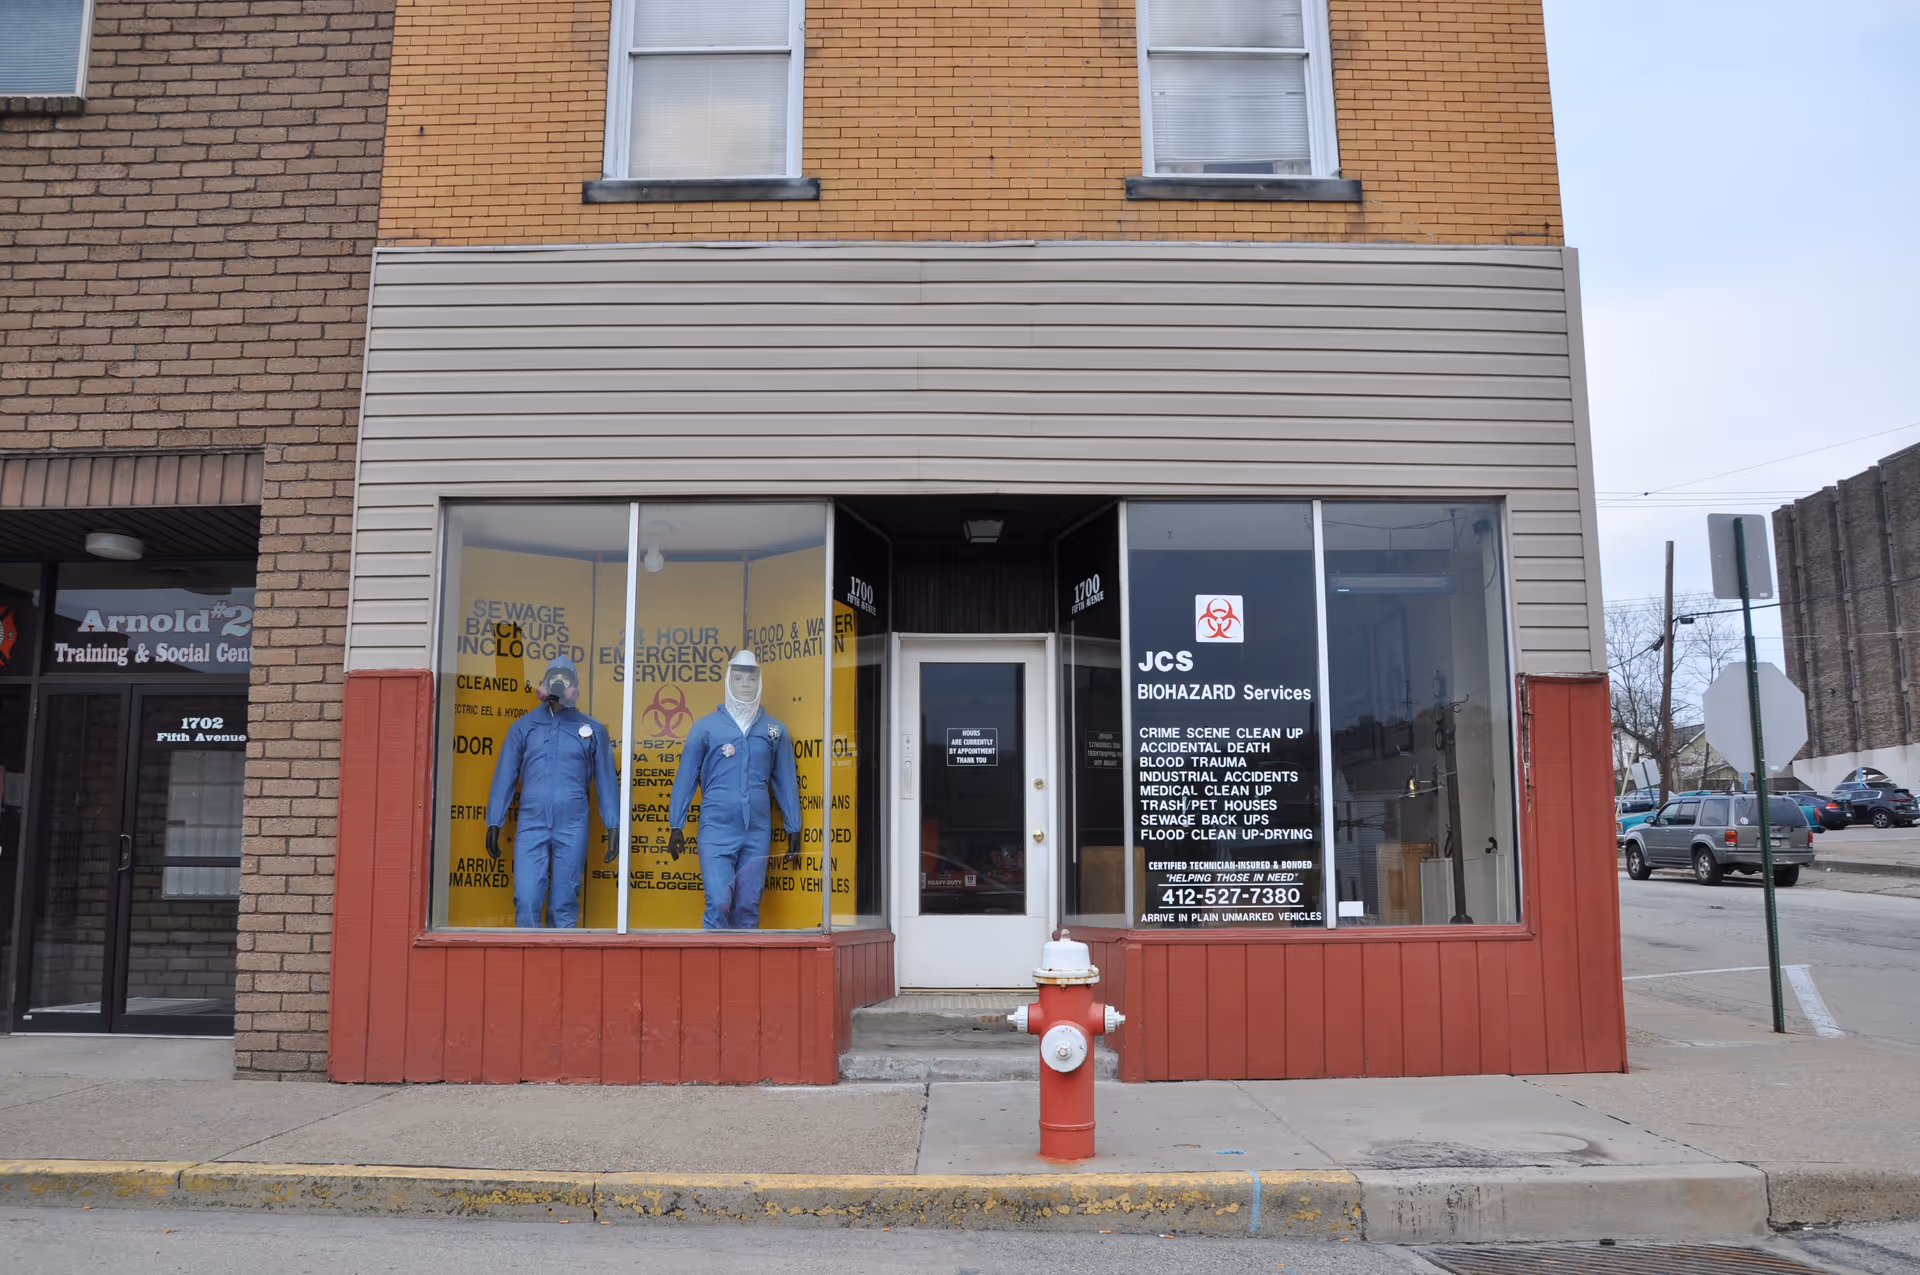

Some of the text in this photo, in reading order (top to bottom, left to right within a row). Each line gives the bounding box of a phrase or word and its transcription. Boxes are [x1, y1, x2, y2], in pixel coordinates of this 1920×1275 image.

[851, 576, 873, 604] 1700
[1074, 573, 1100, 603] 1700
[472, 598, 566, 625] SEWAGE
[77, 609, 210, 633] Arnold
[465, 617, 570, 643] BACKUPS
[746, 613, 853, 647] FLOOD & WAER
[656, 626, 720, 647] HOUR
[55, 643, 129, 666] Training
[134, 642, 150, 664] &
[156, 643, 210, 664] Social
[755, 634, 844, 663] RESTORATIN
[1138, 650, 1194, 673] JCS
[456, 674, 519, 693] CLEANED
[524, 679, 533, 694] &
[1137, 683, 1312, 701] BIOHAZARD Services
[180, 717, 224, 730] 1702
[156, 732, 247, 742] Fifth Avenue
[962, 729, 981, 737] HOURS
[1139, 727, 1304, 739] CRIME SCENE CLEAN UP
[951, 738, 993, 746] ARE CURRENTLY
[1140, 742, 1271, 754] ACCIDENTAL DEATH
[949, 747, 996, 755] BY APPOINTMENT
[956, 756, 987, 764] THANK YOU
[1139, 756, 1247, 768] BLOOD TRAUMA
[635, 768, 676, 777] SCENE
[1139, 771, 1299, 783] INDUSTRIAL ACCIDENTS
[1140, 785, 1272, 797] MEDICAL CLEAN UP
[1141, 799, 1278, 811] TRASH/PET HOUSES
[1140, 814, 1270, 826] SEWAGE BACK UPS
[656, 836, 667, 844] &
[1141, 829, 1313, 841] FLOOD CLEAN UP-DRYING
[457, 857, 505, 873] ARRIVE
[1148, 861, 1187, 871] CERTIFIED
[1273, 861, 1279, 870] &
[1281, 860, 1313, 871] BONDED
[1216, 873, 1250, 882] THOSE
[1253, 873, 1264, 882] IN
[1162, 888, 1300, 905] 412-527-7380
[1141, 911, 1322, 923] ARRIVE IN PLAIN UNMARKED VEHICLES
